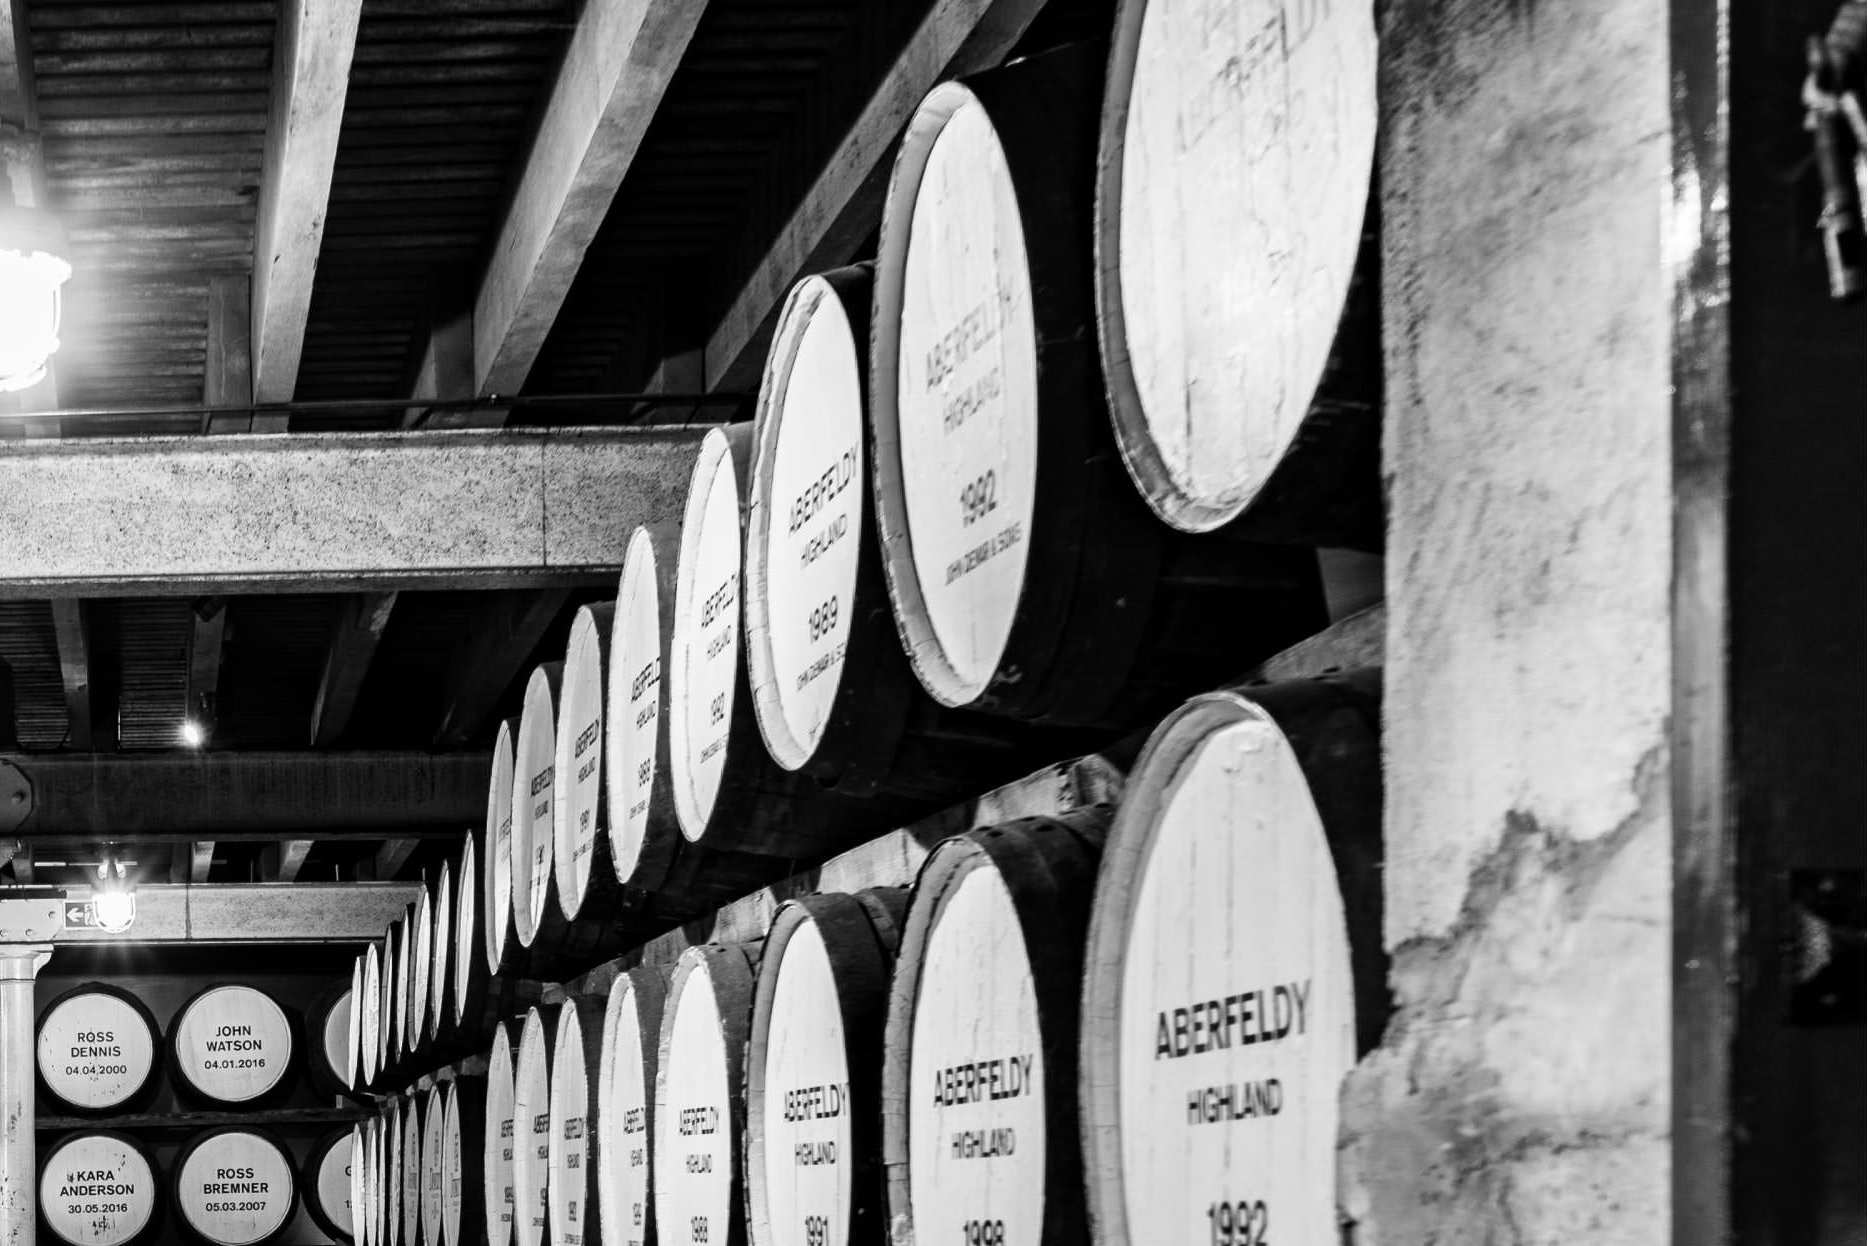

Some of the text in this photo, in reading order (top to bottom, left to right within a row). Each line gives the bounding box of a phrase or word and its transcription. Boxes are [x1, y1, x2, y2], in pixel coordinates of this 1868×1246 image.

[788, 441, 860, 538] ABERFELDY
[960, 468, 998, 529] 1992
[801, 513, 848, 571] HIGHLAND
[808, 595, 839, 645] 1989
[1155, 979, 1312, 1061] ABERFELDY
[77, 1031, 114, 1043] ROSS
[215, 1025, 251, 1037] JOHN
[71, 1045, 121, 1058] DENNIS
[206, 1039, 263, 1052] WATSON
[65, 1064, 127, 1076] 04.04.2000
[204, 1058, 266, 1070] 04.01.2016
[934, 1053, 1033, 1108] ABERFELDY
[784, 1082, 850, 1122] ABERFELDY
[1187, 1079, 1284, 1126] HIGHLAND
[951, 1127, 1016, 1160] HIGHLAND
[794, 1140, 836, 1166] HIGHLAND
[77, 1170, 115, 1182] KARA
[217, 1167, 254, 1180] ROSS
[59, 1183, 135, 1197] ANDERSON
[203, 1182, 269, 1195] BREMNER
[68, 1203, 128, 1214] 30.05.2016
[205, 1201, 266, 1212] 05.03.2007
